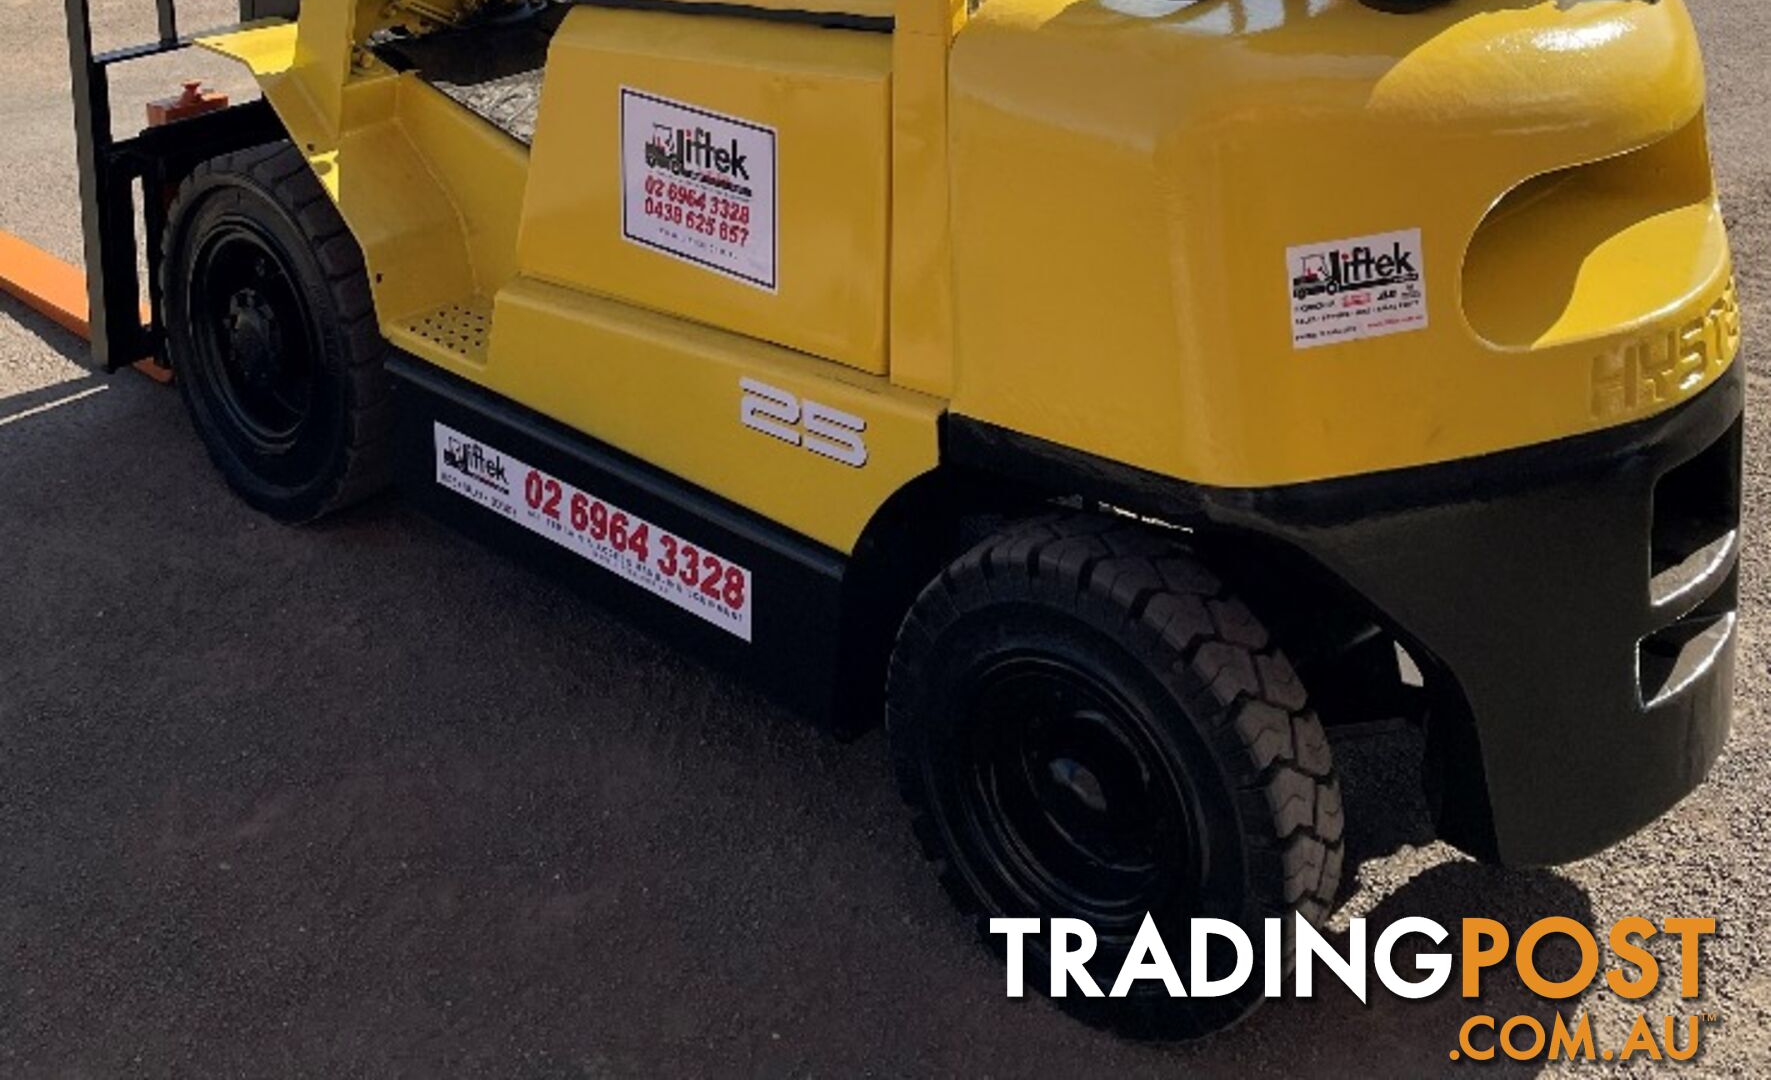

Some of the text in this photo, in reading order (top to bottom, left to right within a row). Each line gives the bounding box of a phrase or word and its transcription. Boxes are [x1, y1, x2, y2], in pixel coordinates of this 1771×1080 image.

[645, 175, 665, 197] 02
[668, 182, 706, 212] 6964
[710, 196, 749, 226] 3328
[686, 211, 716, 236] 625
[739, 375, 868, 468] 25
[524, 470, 562, 520] 02
[570, 493, 649, 563] 6964
[658, 535, 746, 611] 3328
